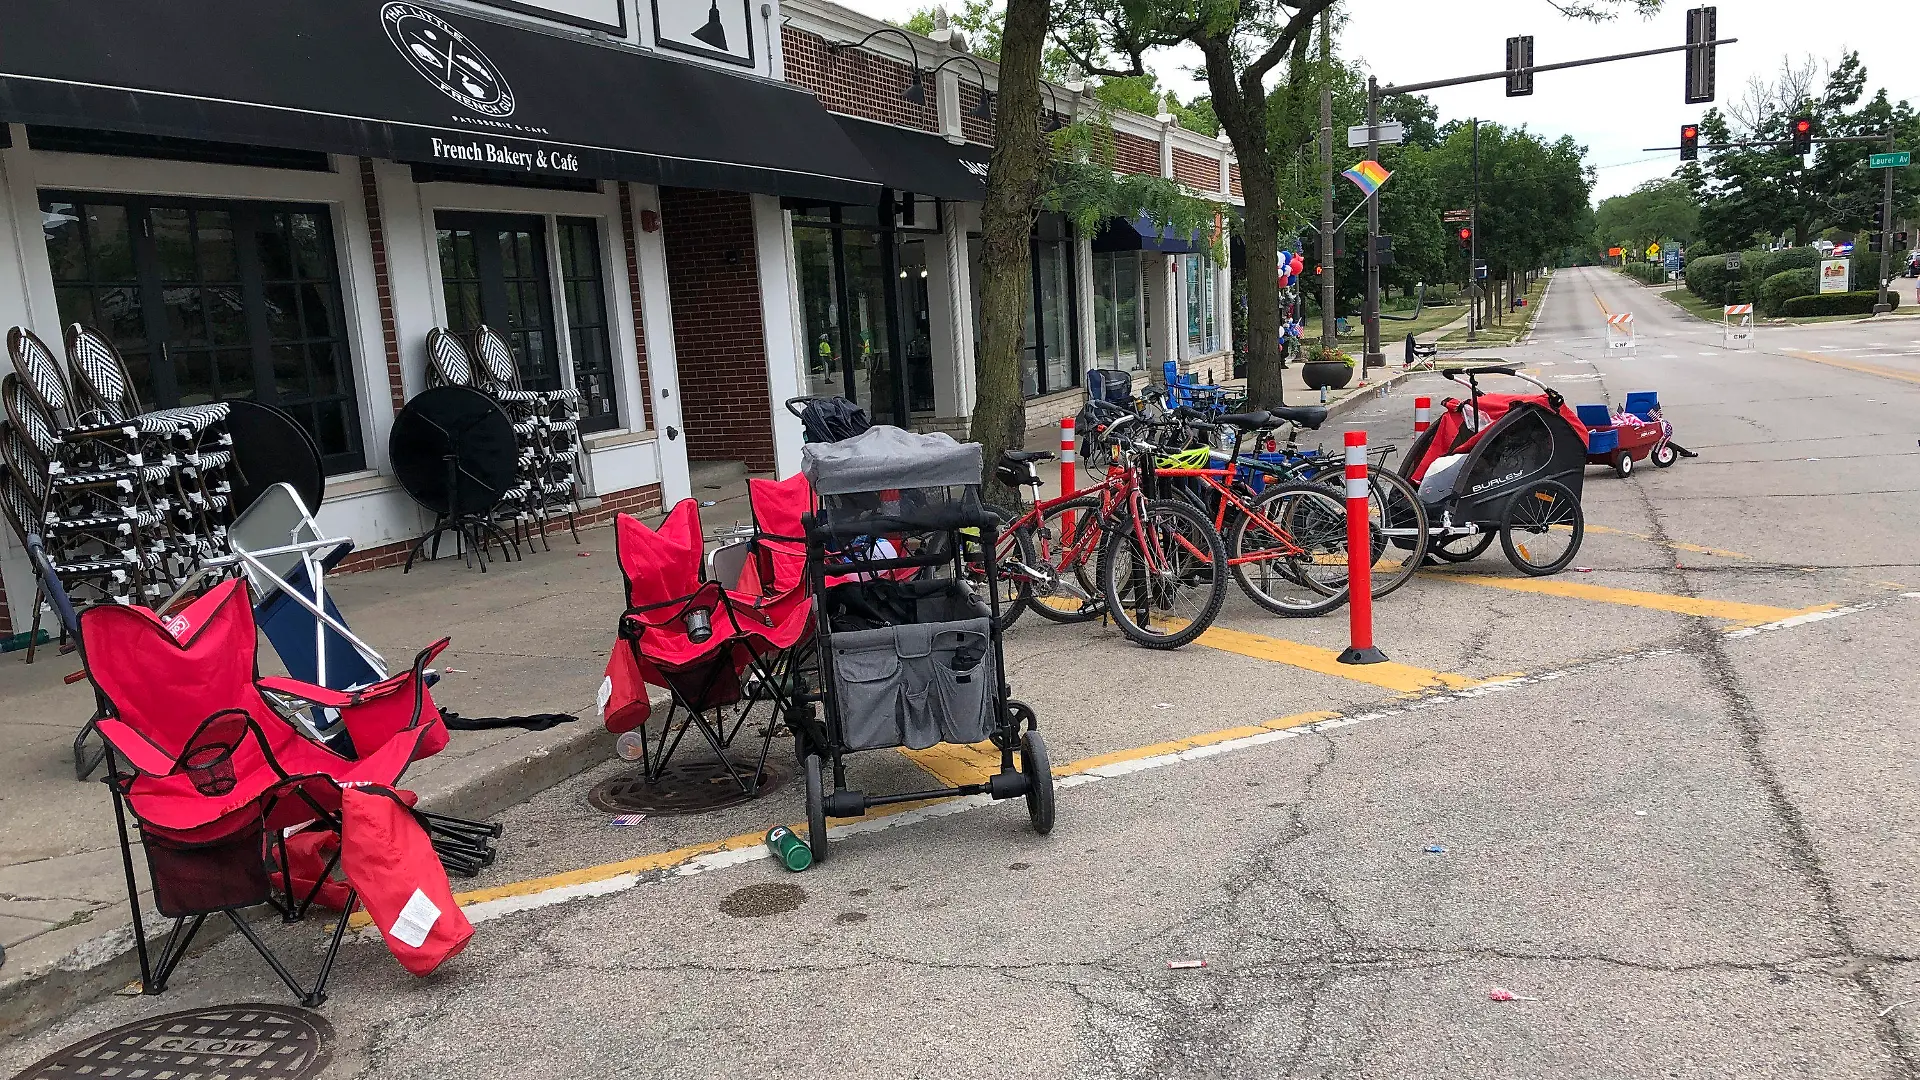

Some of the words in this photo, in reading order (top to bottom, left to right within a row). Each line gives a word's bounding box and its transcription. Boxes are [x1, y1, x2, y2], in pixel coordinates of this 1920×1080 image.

[385, 5, 408, 23] THAT
[410, 7, 463, 42] LITTLE
[440, 82, 502, 114] FRENCH
[499, 90, 512, 112] GUY
[451, 115, 513, 129] PATISSERIE
[430, 137, 484, 161] French
[485, 143, 533, 171] Bakery
[535, 149, 548, 168] &
[550, 151, 579, 172] Café
[1872, 156, 1895, 165] Laurel
[1899, 155, 1909, 163] Av
[1472, 469, 1524, 492] BURLEY
[160, 1039, 257, 1053] CLOW
